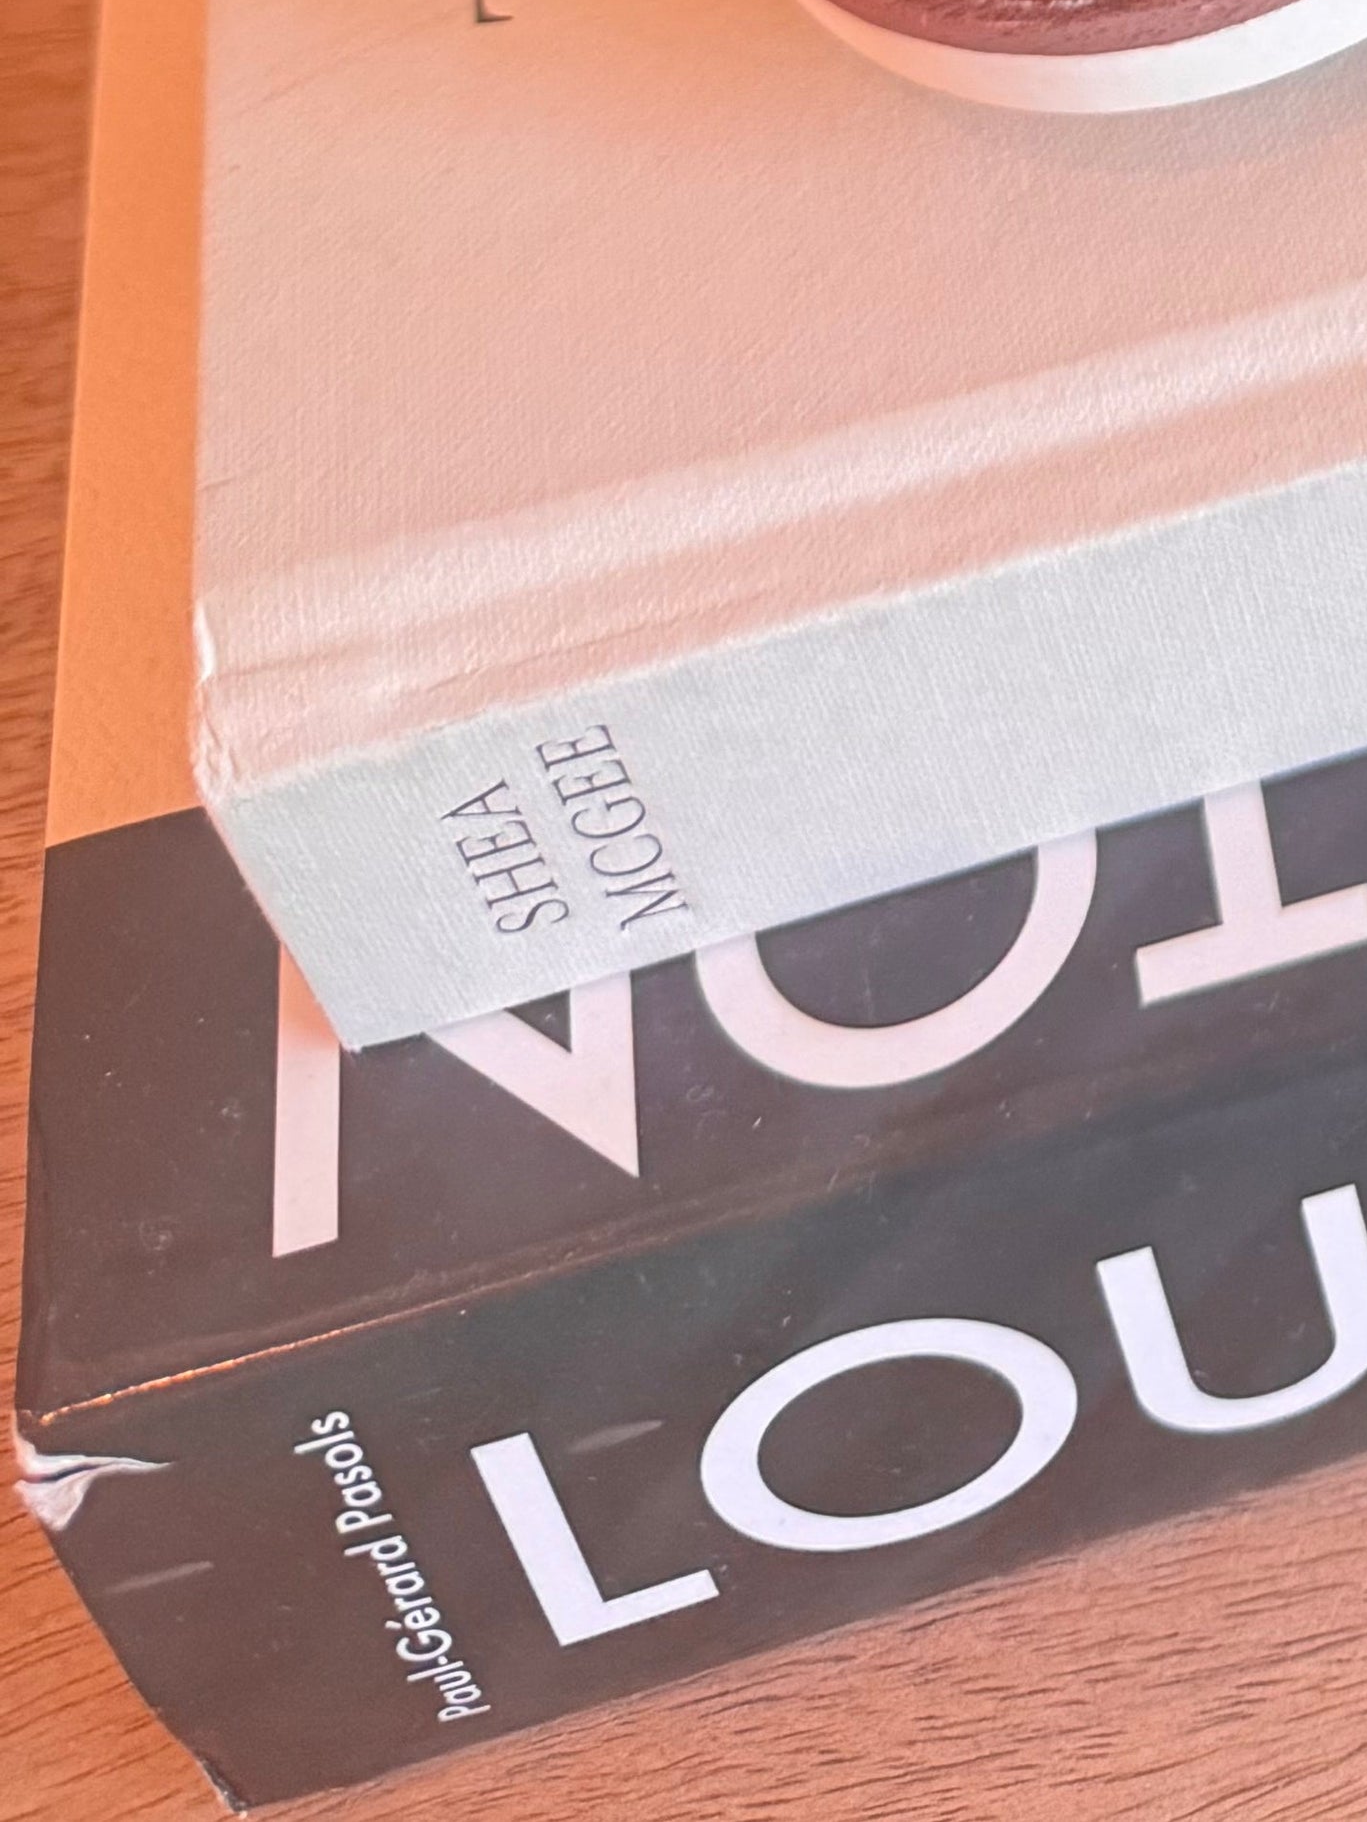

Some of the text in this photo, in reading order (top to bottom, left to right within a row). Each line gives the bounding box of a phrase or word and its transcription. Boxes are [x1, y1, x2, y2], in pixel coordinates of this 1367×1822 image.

[441, 780, 570, 935] SHEA
[535, 724, 690, 931] MCGEE
[293, 1410, 492, 1723] Paul-Gérard Pasols
